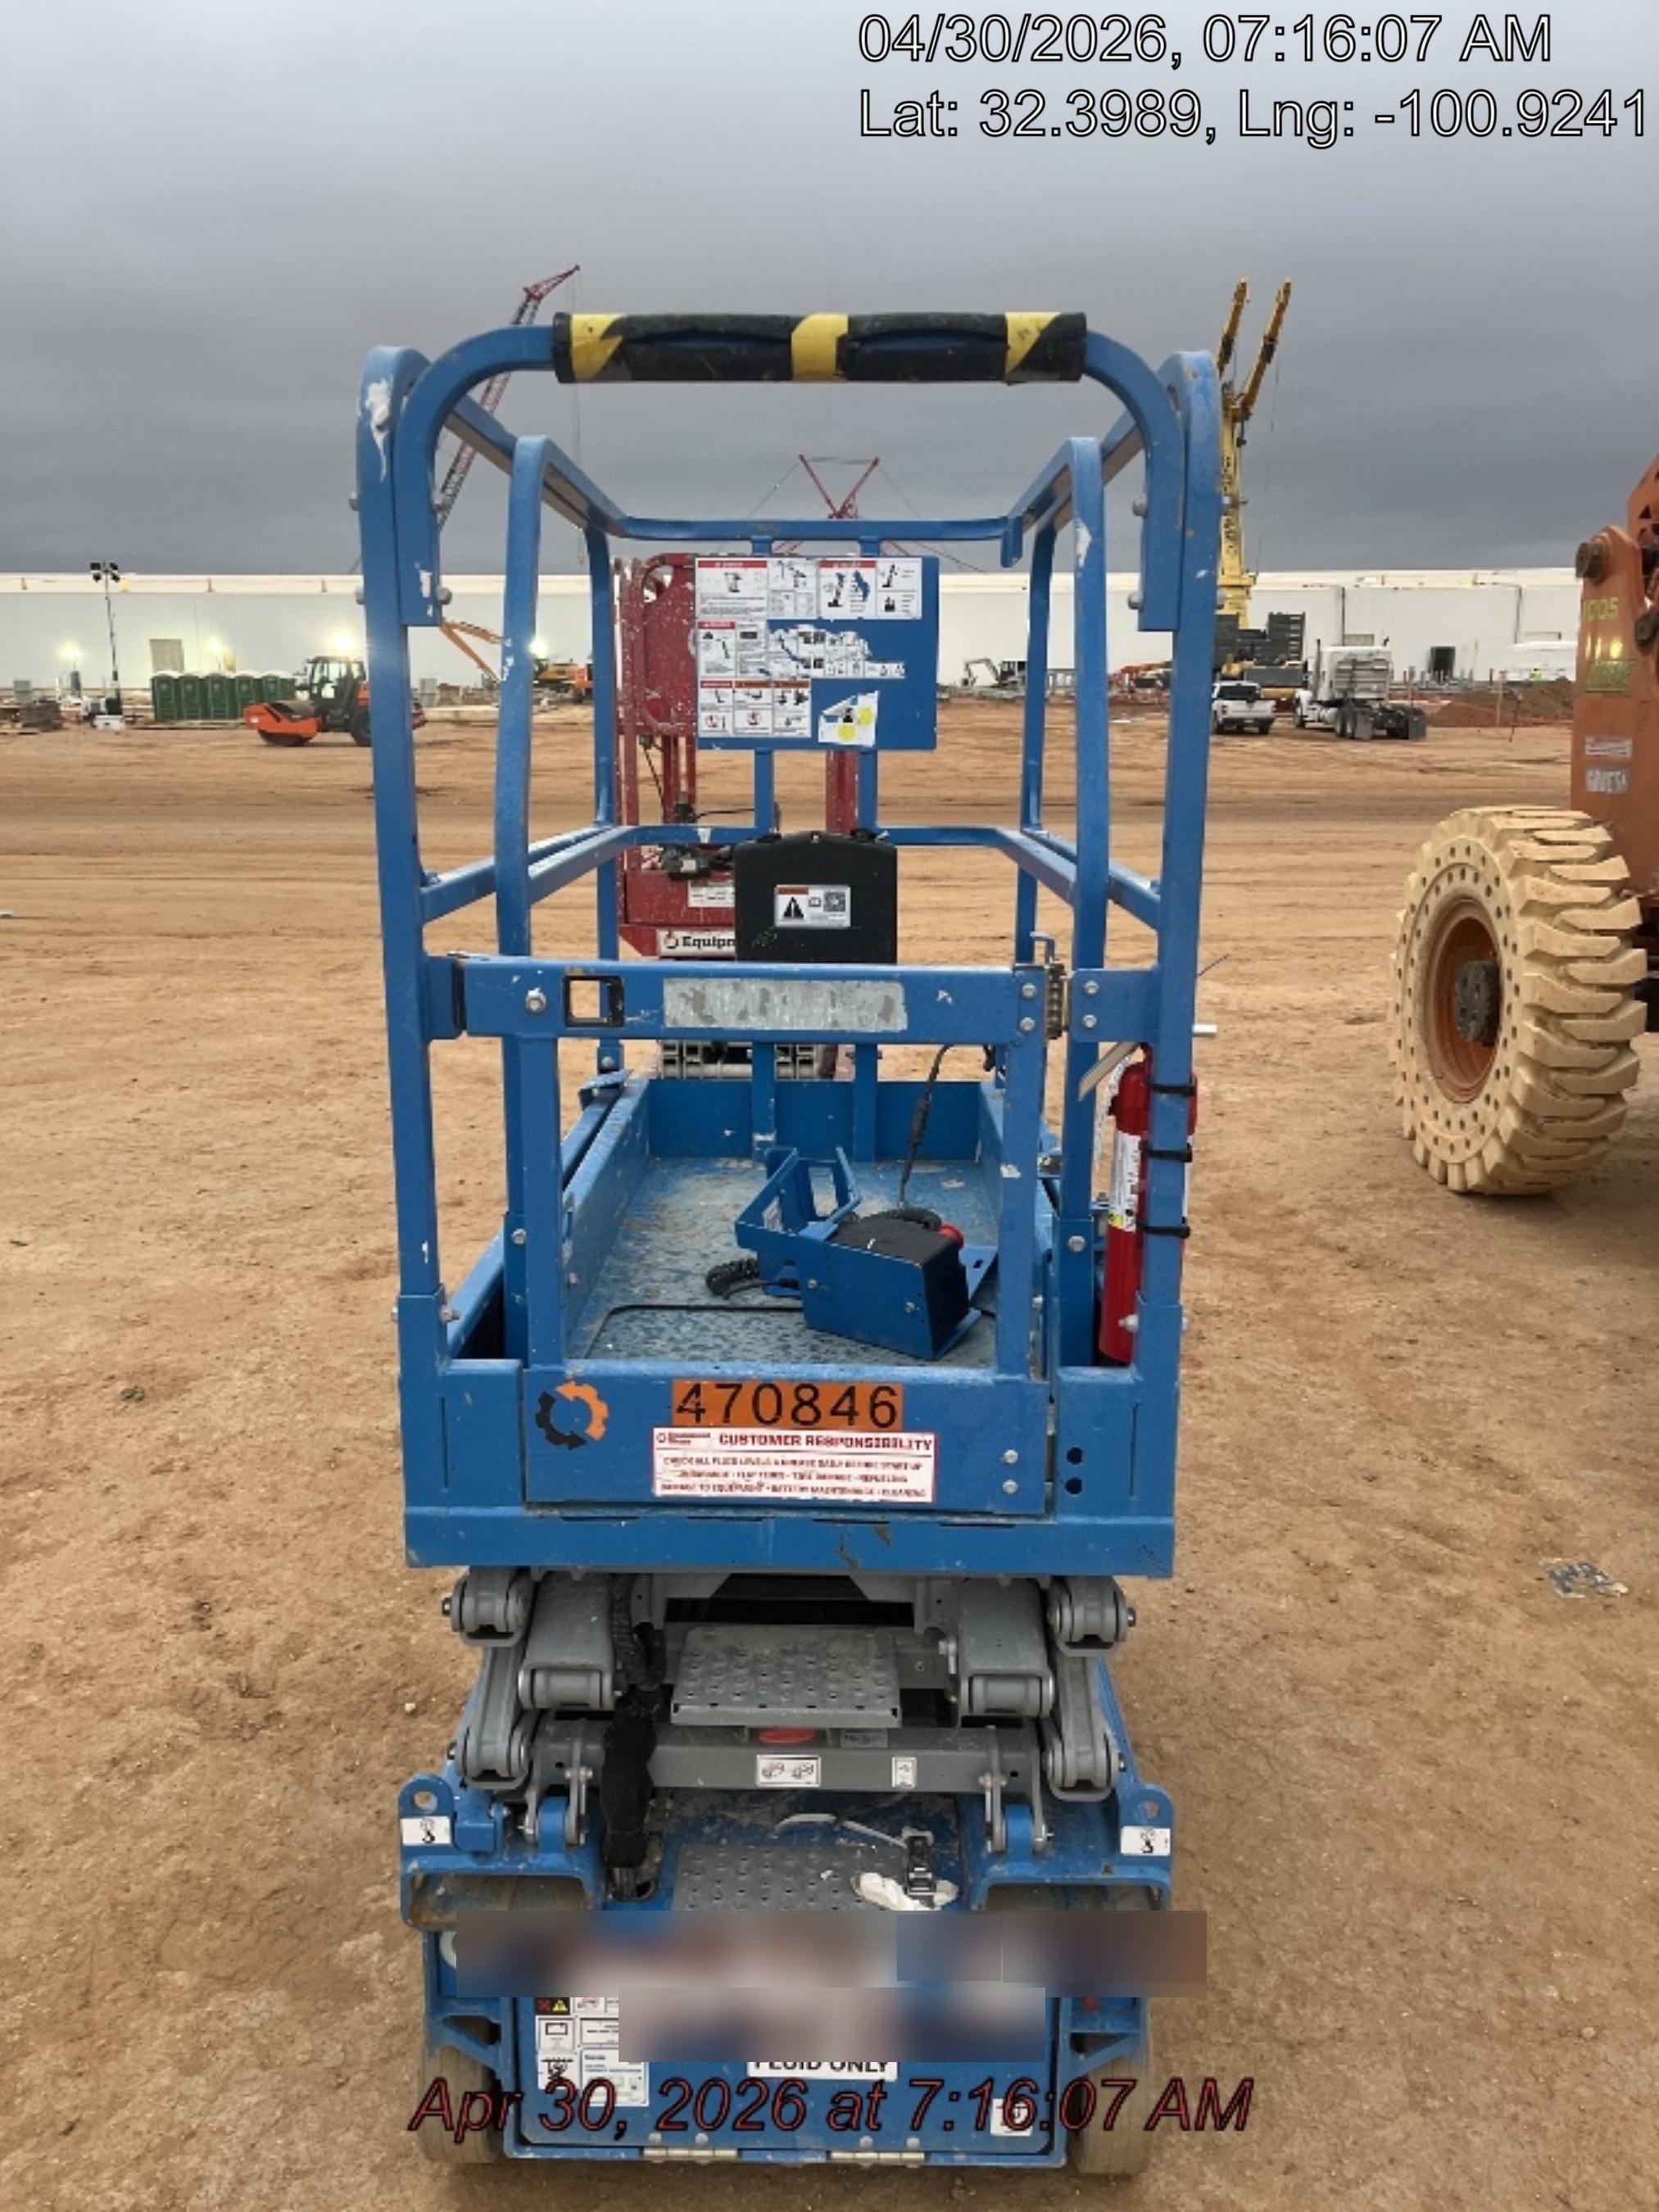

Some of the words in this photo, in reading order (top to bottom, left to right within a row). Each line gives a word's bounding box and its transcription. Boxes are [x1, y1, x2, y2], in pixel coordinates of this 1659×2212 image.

[676, 1382, 898, 1429] 470846
[718, 1434, 801, 1446] CUSTOMER
[805, 1435, 932, 1451] RESPONSIBILITY
